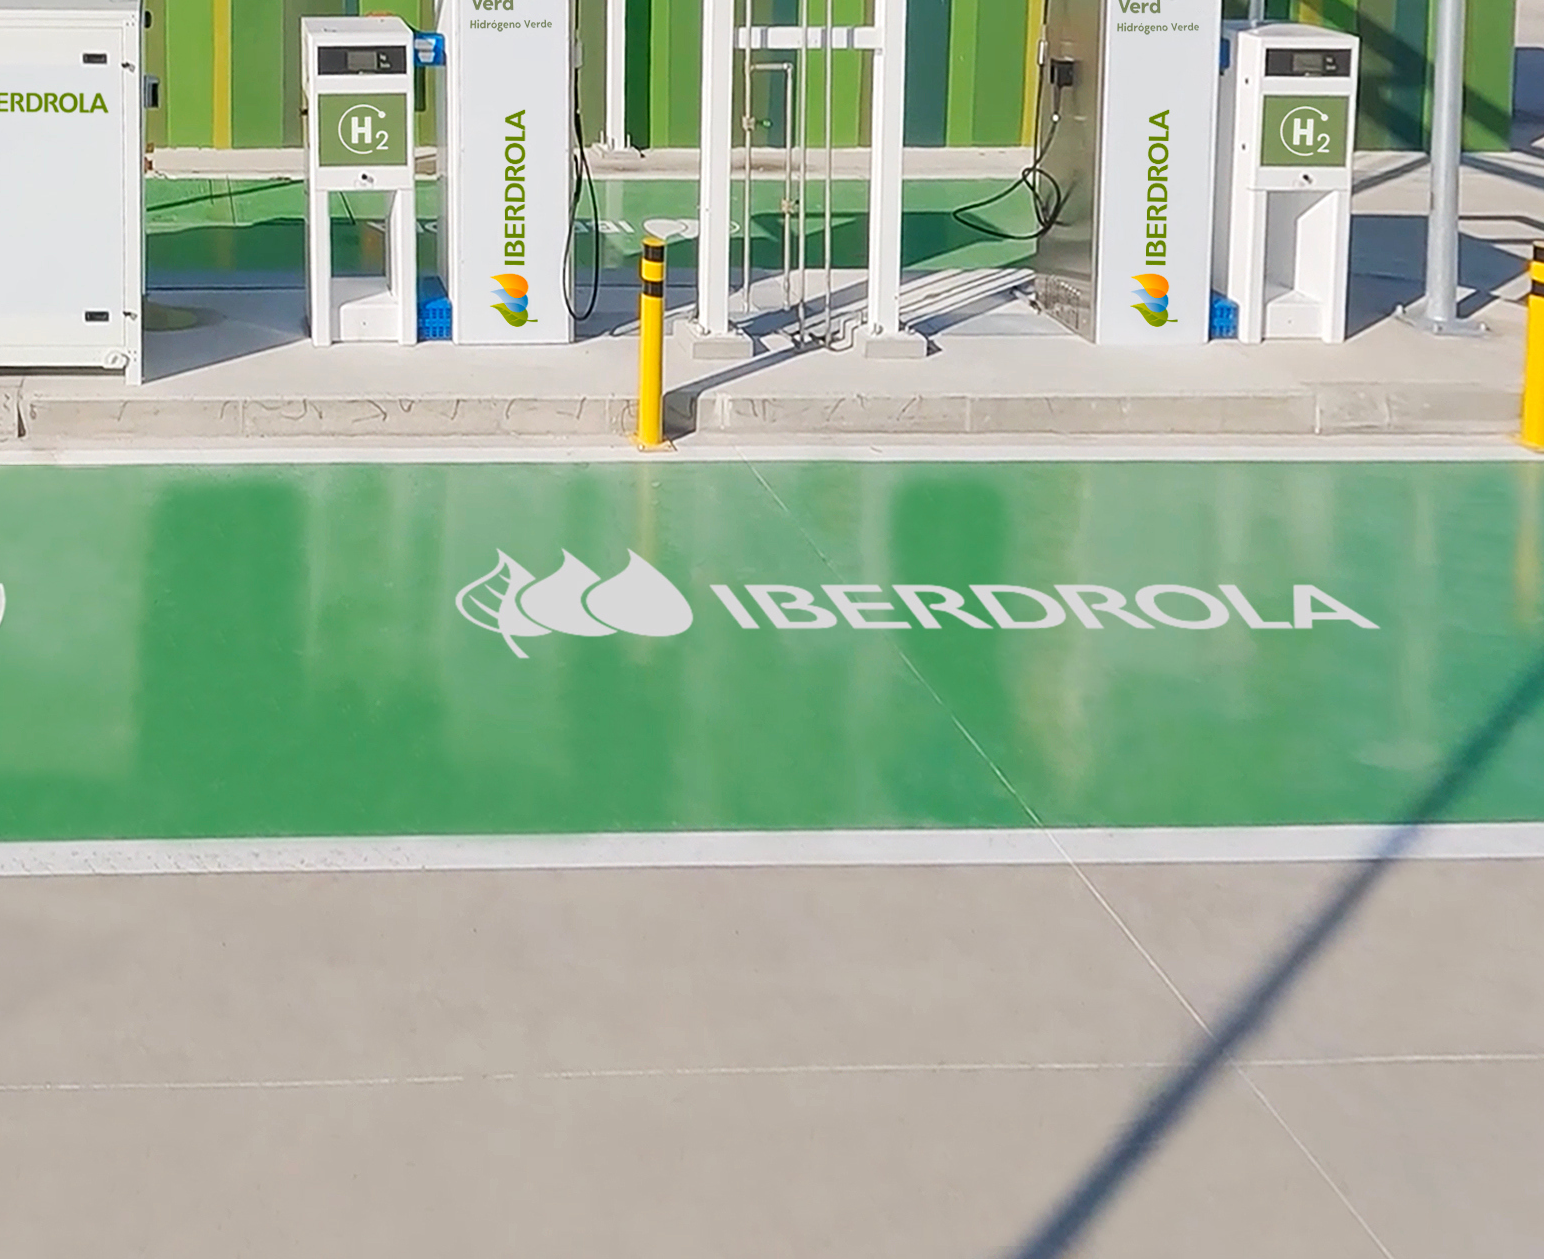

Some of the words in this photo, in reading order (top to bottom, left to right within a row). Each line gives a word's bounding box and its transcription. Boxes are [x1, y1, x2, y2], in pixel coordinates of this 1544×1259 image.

[470, 19, 521, 32] Hidrógeno
[524, 19, 553, 29] Verde
[1117, 22, 1168, 35] Hidrógeno
[1171, 22, 1200, 32] Verde
[504, 109, 526, 266] IBERDROLA
[1145, 109, 1170, 266] IBERDROLA
[708, 583, 1381, 630] IBERDROLA
